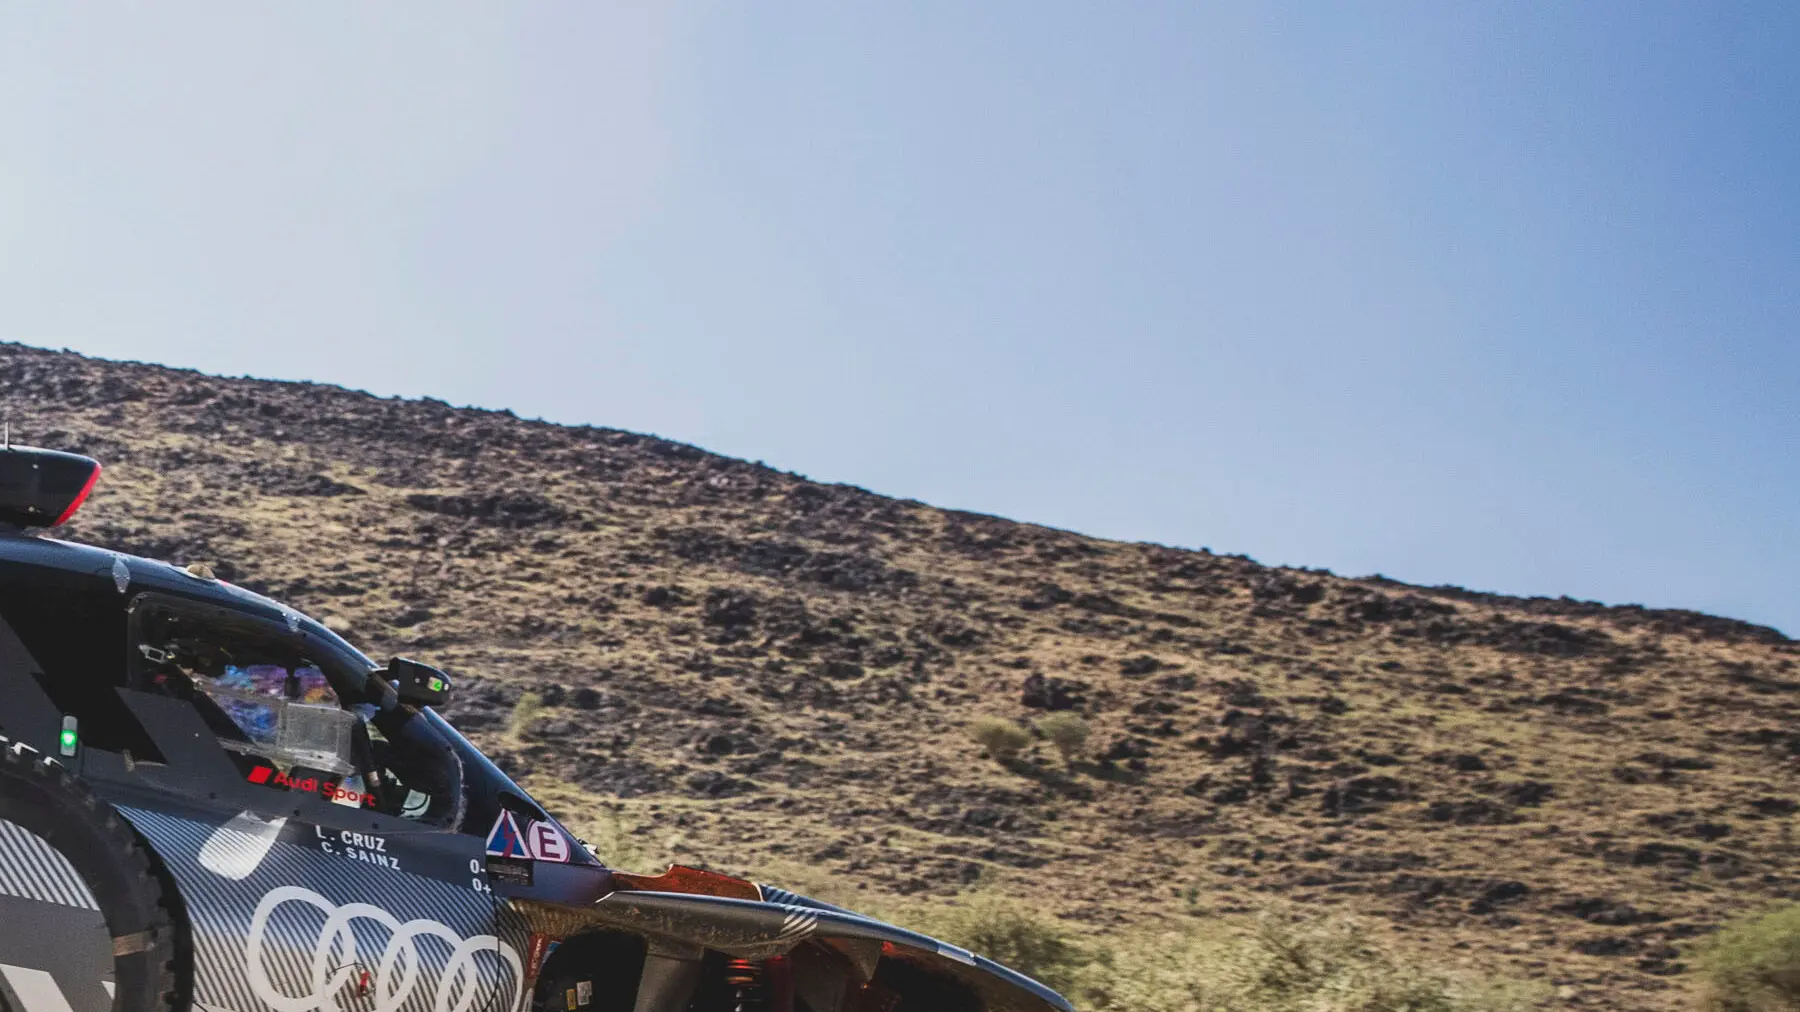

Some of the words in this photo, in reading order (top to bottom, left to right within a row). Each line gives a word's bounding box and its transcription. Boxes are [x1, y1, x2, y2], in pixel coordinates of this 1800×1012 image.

[272, 770, 318, 793] Audi
[322, 781, 377, 808] Sport
[315, 824, 336, 841] L.
[341, 830, 387, 853] CRUZ
[537, 826, 561, 859] E
[321, 841, 341, 855] C.
[345, 846, 401, 871] SAINZ
